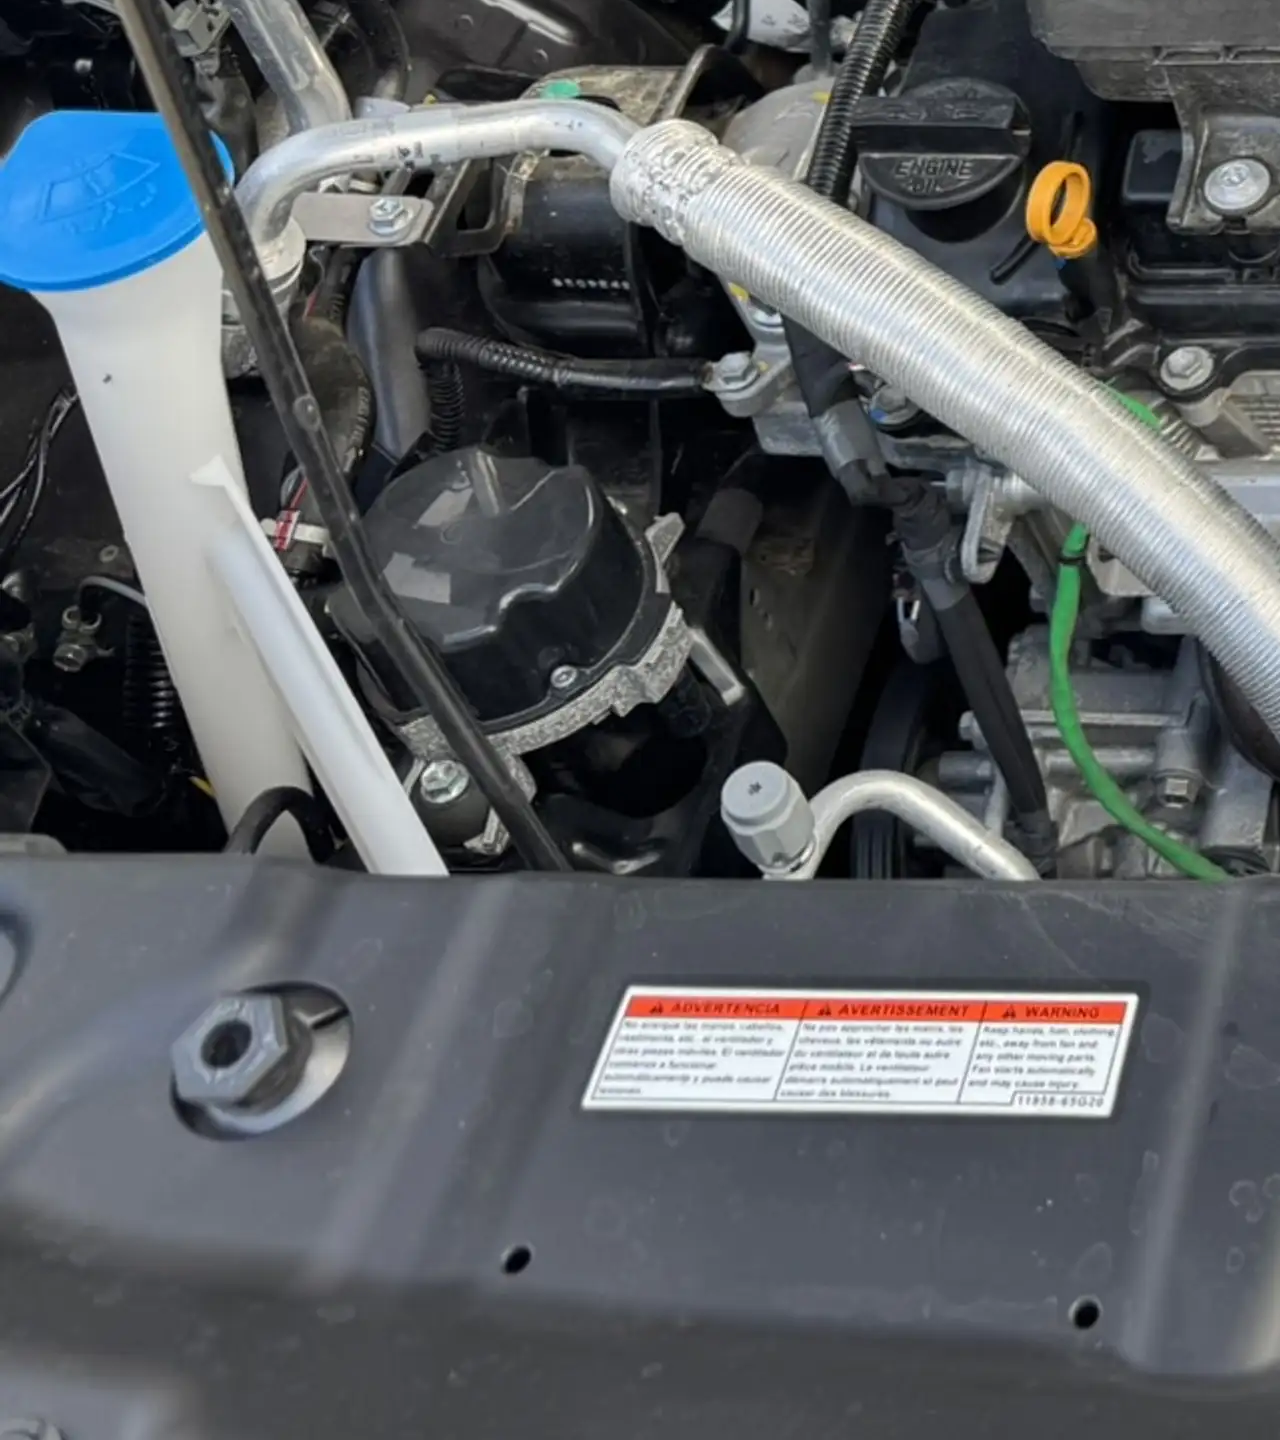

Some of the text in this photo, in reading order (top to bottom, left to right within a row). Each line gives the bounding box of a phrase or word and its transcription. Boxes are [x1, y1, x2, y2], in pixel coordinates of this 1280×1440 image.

[895, 159, 973, 179] ENGINE
[671, 1002, 780, 1015] ADVERTENCIA
[838, 1003, 969, 1017] AVERTISSEMENT
[1025, 1005, 1100, 1019] WARNING
